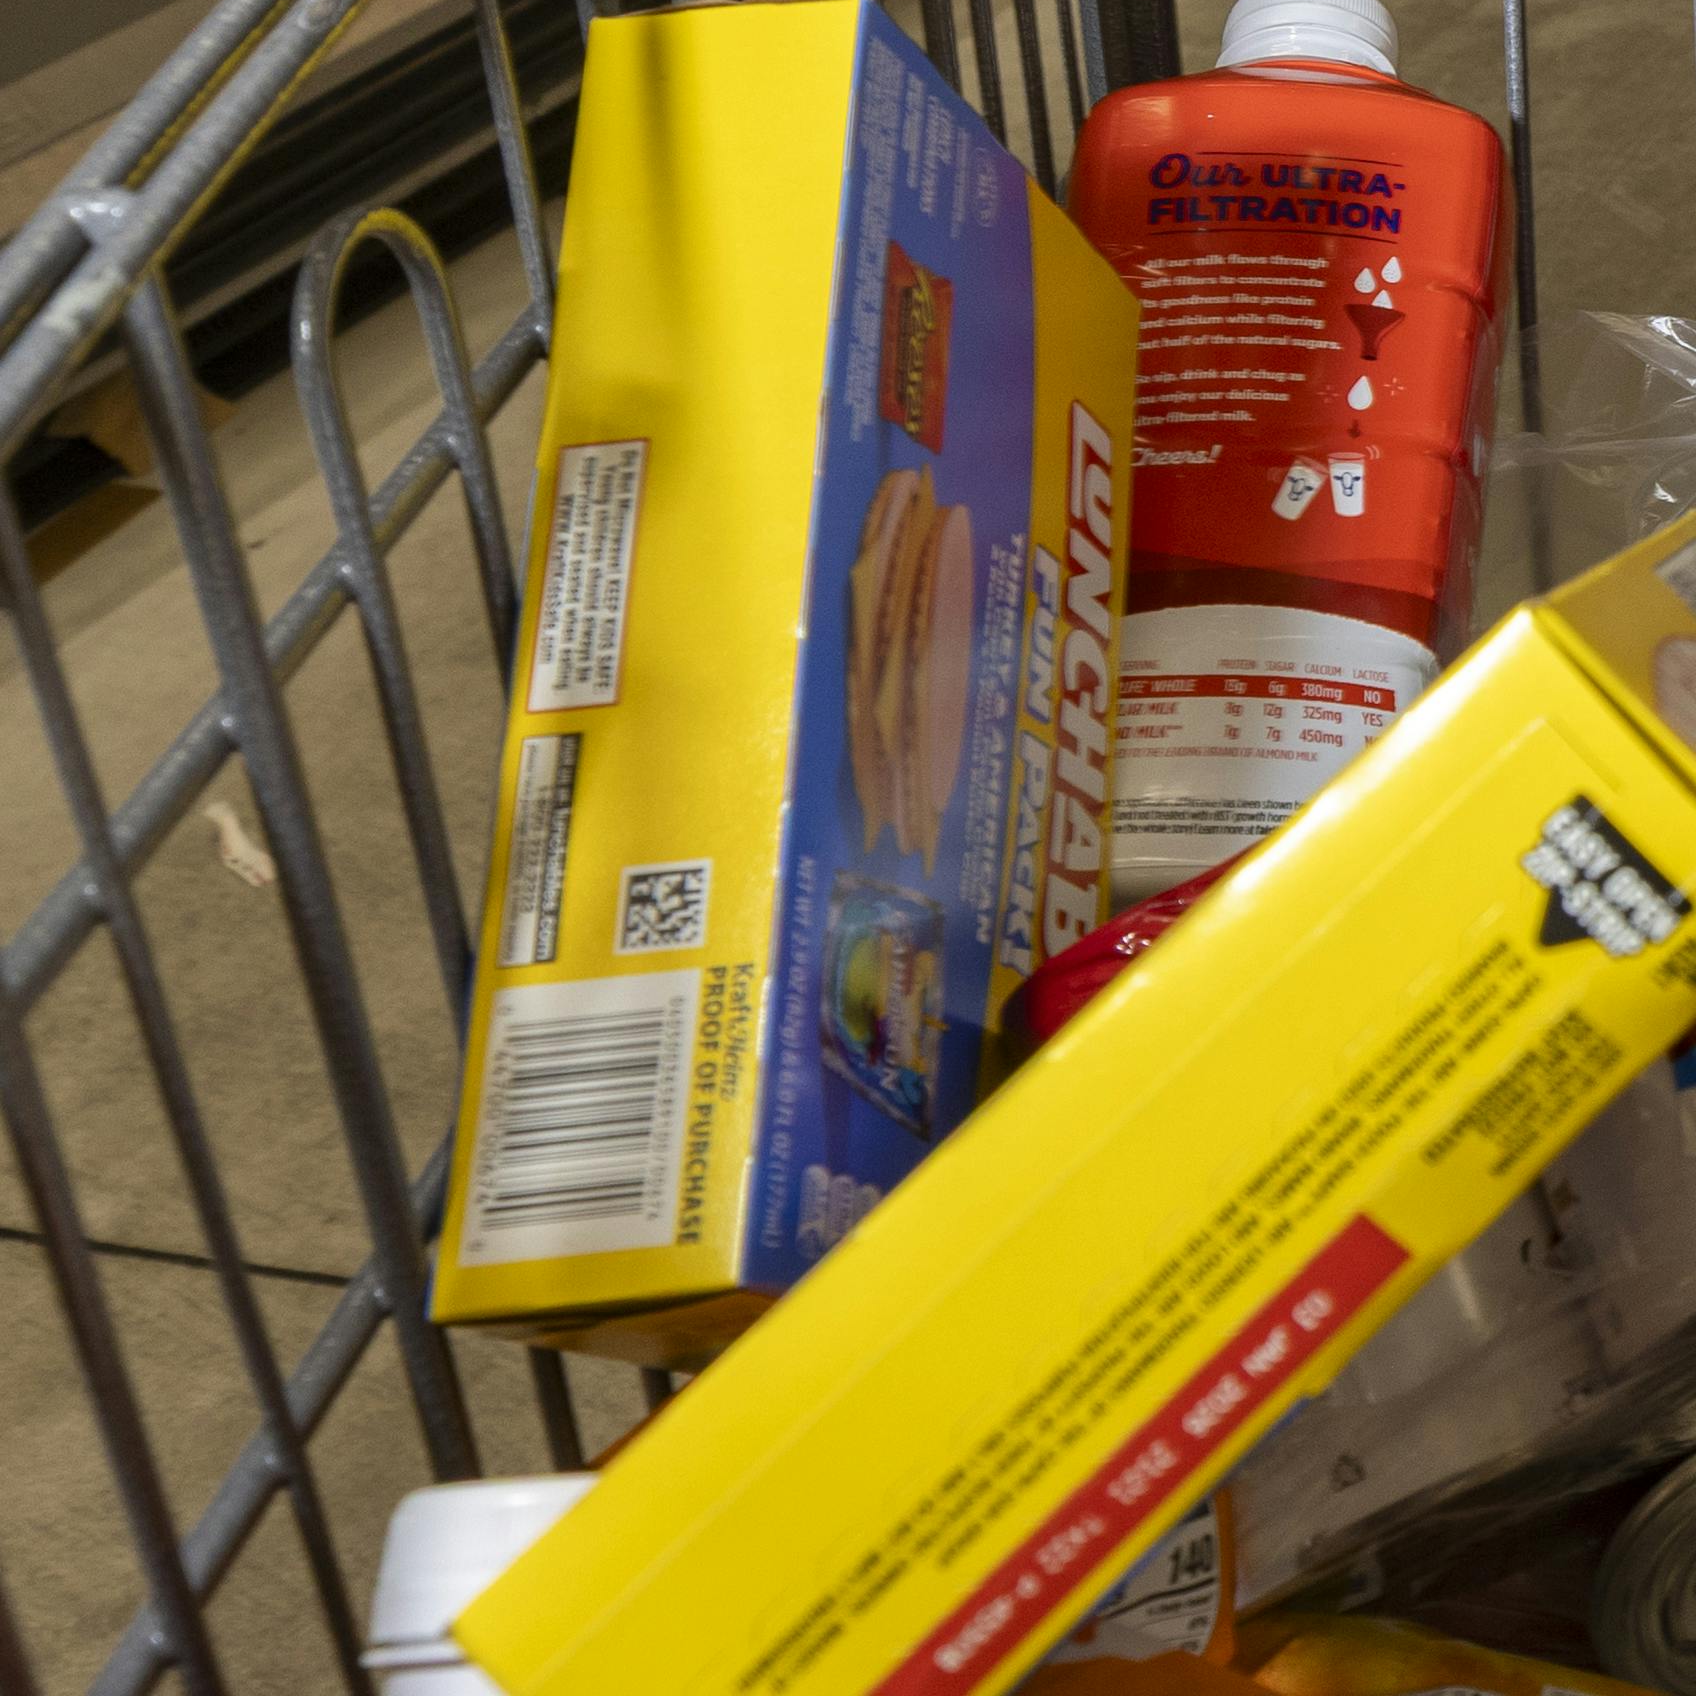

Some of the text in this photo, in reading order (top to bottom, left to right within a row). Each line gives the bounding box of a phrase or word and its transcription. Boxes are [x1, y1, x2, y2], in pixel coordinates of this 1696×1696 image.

[1148, 153, 1405, 199] Our ULTRA-
[1146, 195, 1403, 235] FILTRATION
[1144, 253, 1328, 269] All our milk flows through
[1162, 292, 1315, 311] goodness like protein
[1167, 311, 1325, 329] calcium while filtering
[1264, 661, 1295, 672] SUGAR
[1304, 664, 1343, 676] CALCIUM
[1353, 669, 1390, 682] LACTOSE
[1267, 680, 1381, 704] 6g 380mg NO
[1262, 704, 1383, 727] 12g 325mg YES
[971, 531, 1025, 944] TURKEY & AMERICAN
[1266, 727, 1343, 747] 7g 450mg
[1541, 804, 1625, 896] EASY
[1612, 860, 1694, 944] OPEN
[675, 962, 729, 1248] PROOF OF PURCHASE
